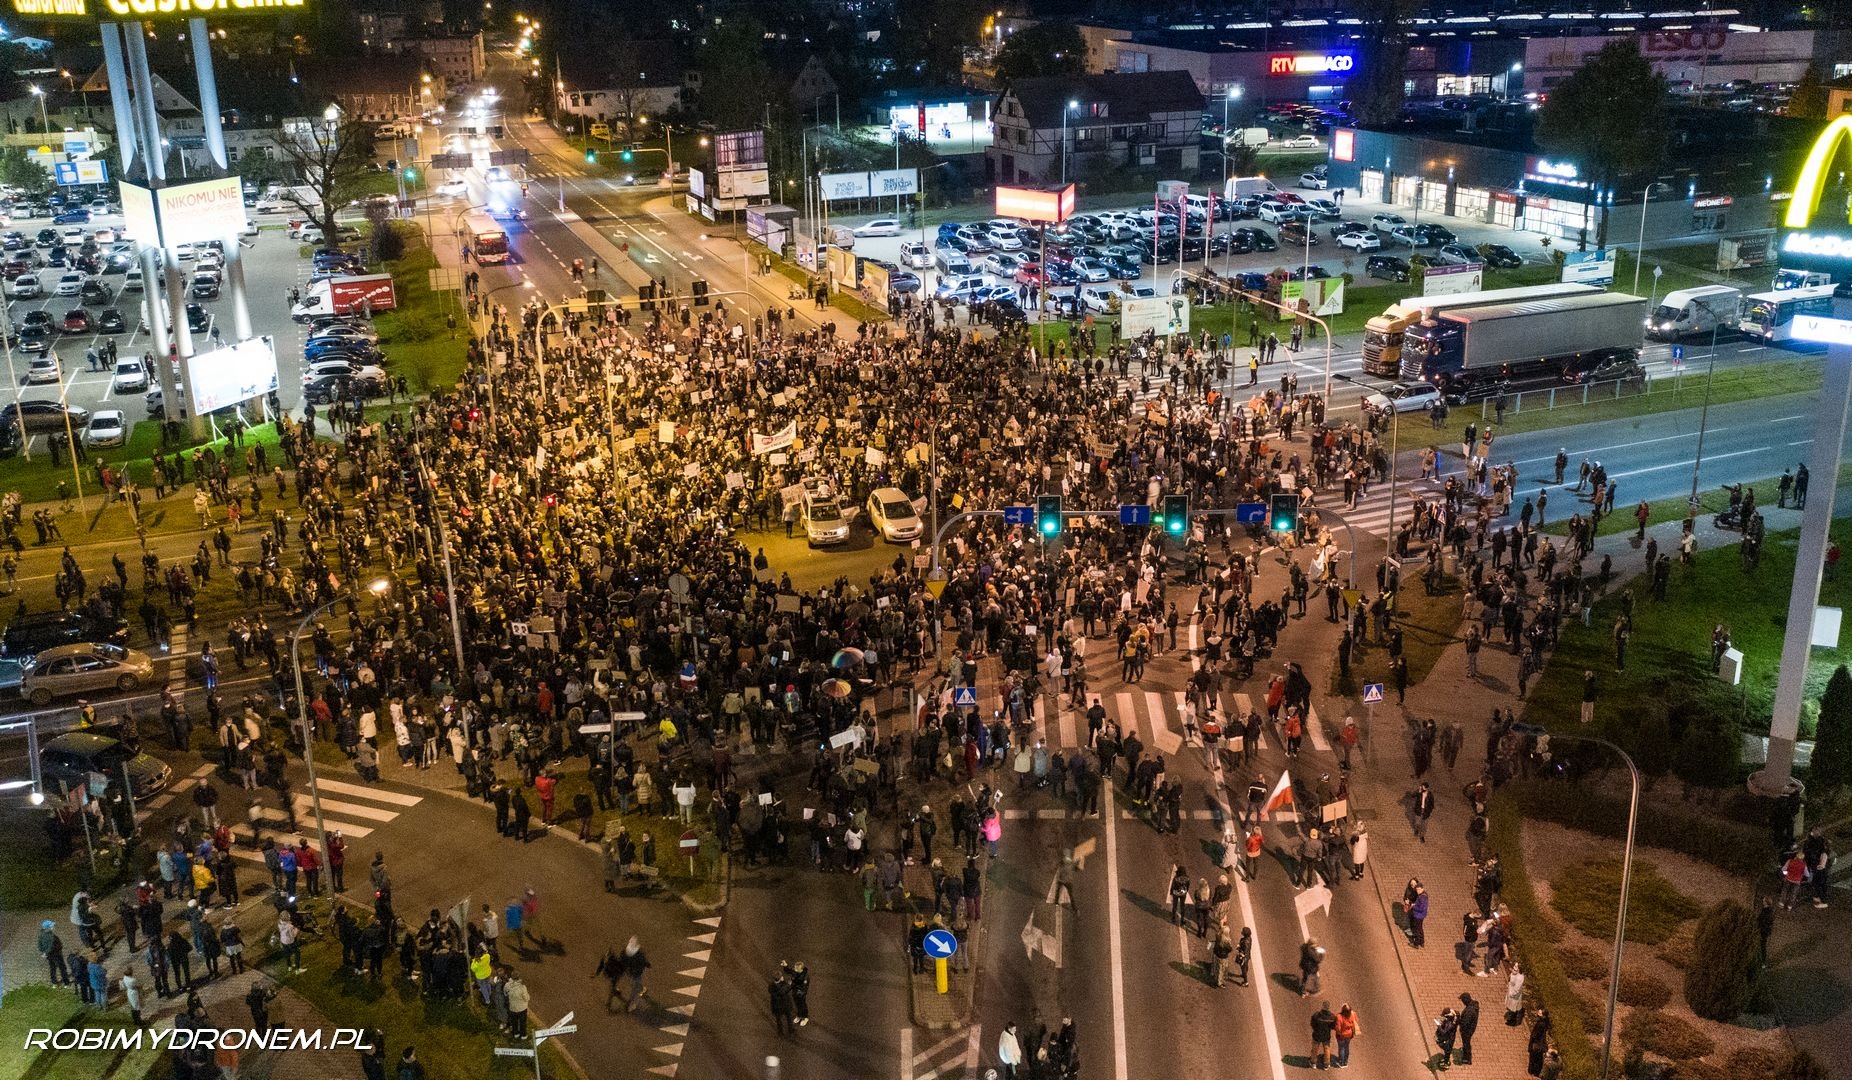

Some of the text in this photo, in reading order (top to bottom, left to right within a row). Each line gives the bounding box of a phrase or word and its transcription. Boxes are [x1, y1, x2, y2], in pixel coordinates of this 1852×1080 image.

[1646, 32, 1727, 51] ESCO
[1271, 57, 1297, 73] RTV
[166, 186, 238, 210] NIKOMU NIE
[1698, 197, 1725, 208] NEONET
[1773, 191, 1792, 200] NEON
